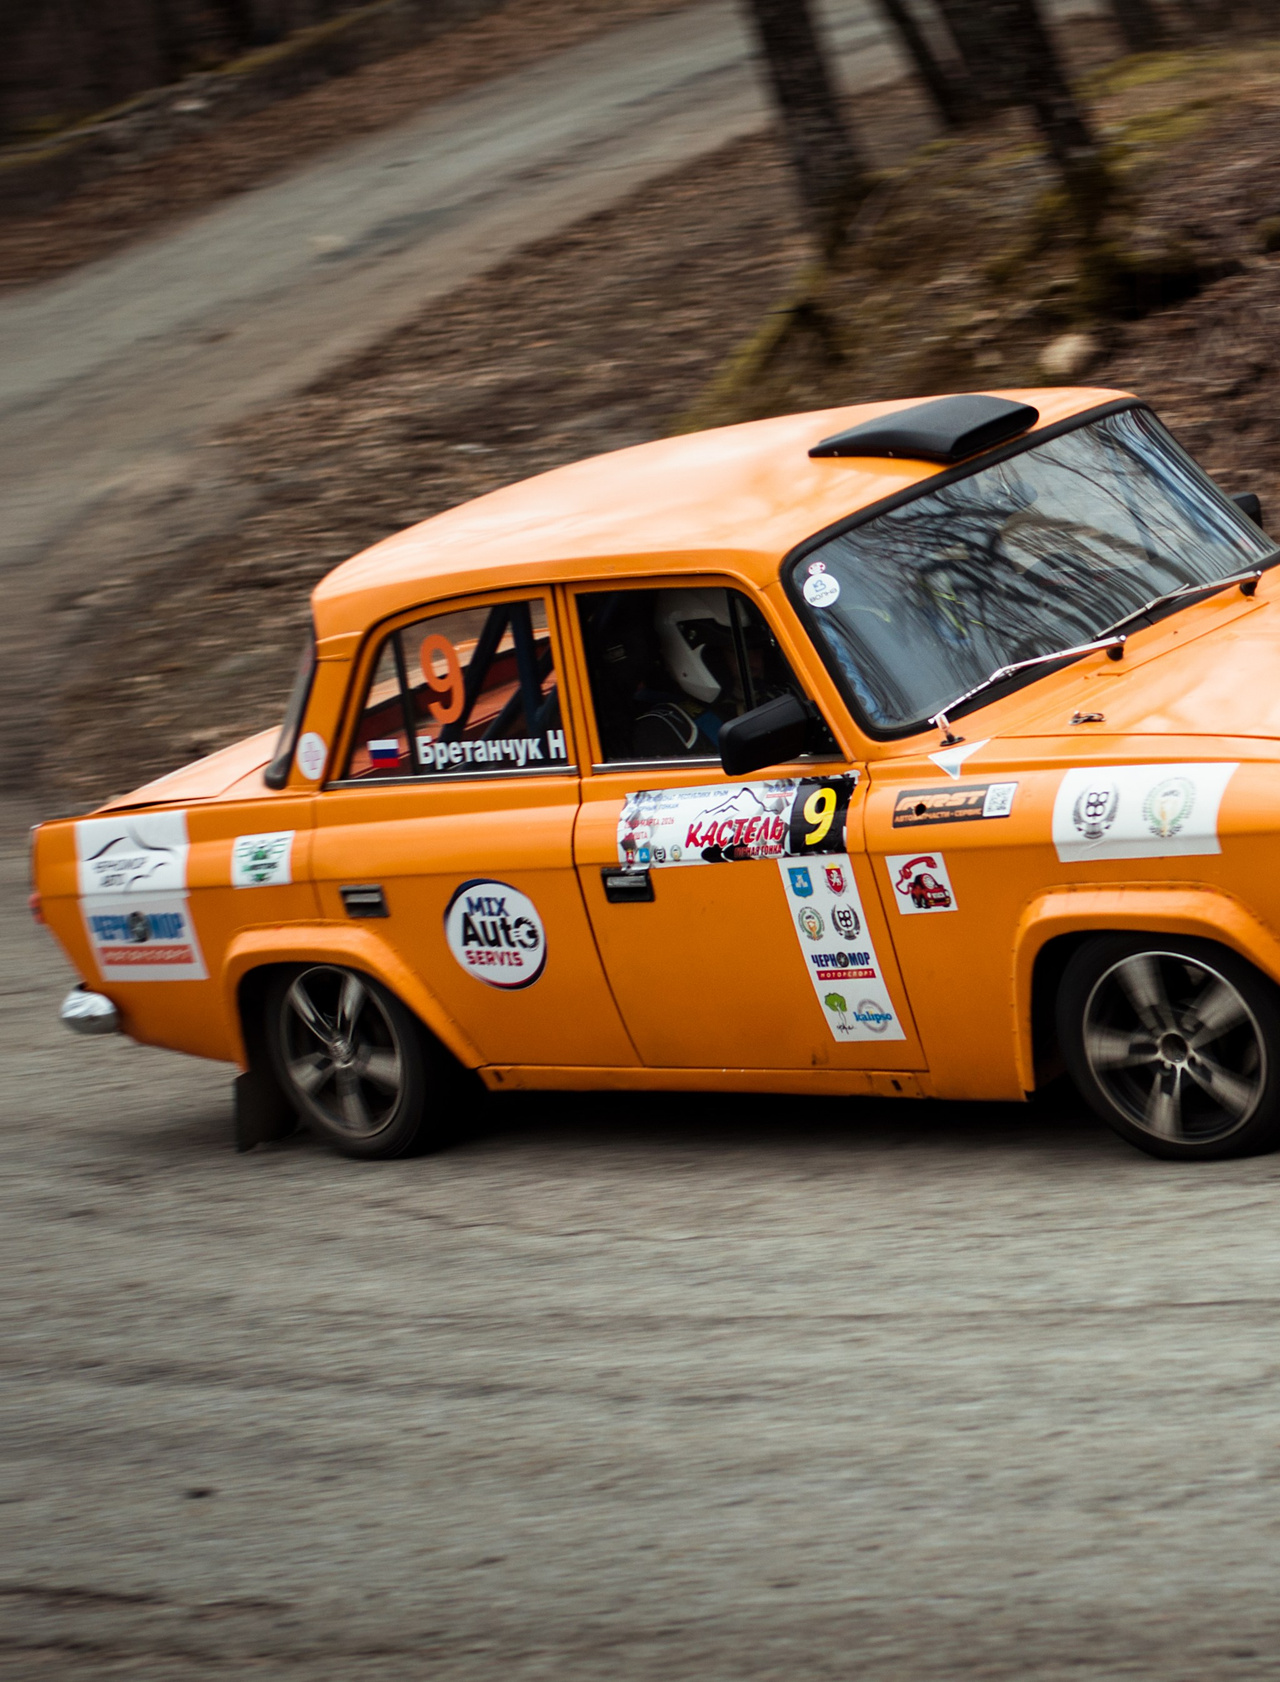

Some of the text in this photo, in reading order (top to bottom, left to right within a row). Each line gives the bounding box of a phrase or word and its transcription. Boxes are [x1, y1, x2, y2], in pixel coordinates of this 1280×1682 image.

[420, 633, 465, 725] 9
[416, 729, 567, 770] Бретанчук Н
[895, 790, 987, 811] FIRST
[804, 787, 837, 846] 9
[685, 815, 785, 849] КАСТЕЛЬ
[465, 896, 510, 917] MIX
[465, 950, 524, 967] SERVIS
[820, 970, 873, 979] МОТОРСПОРТ
